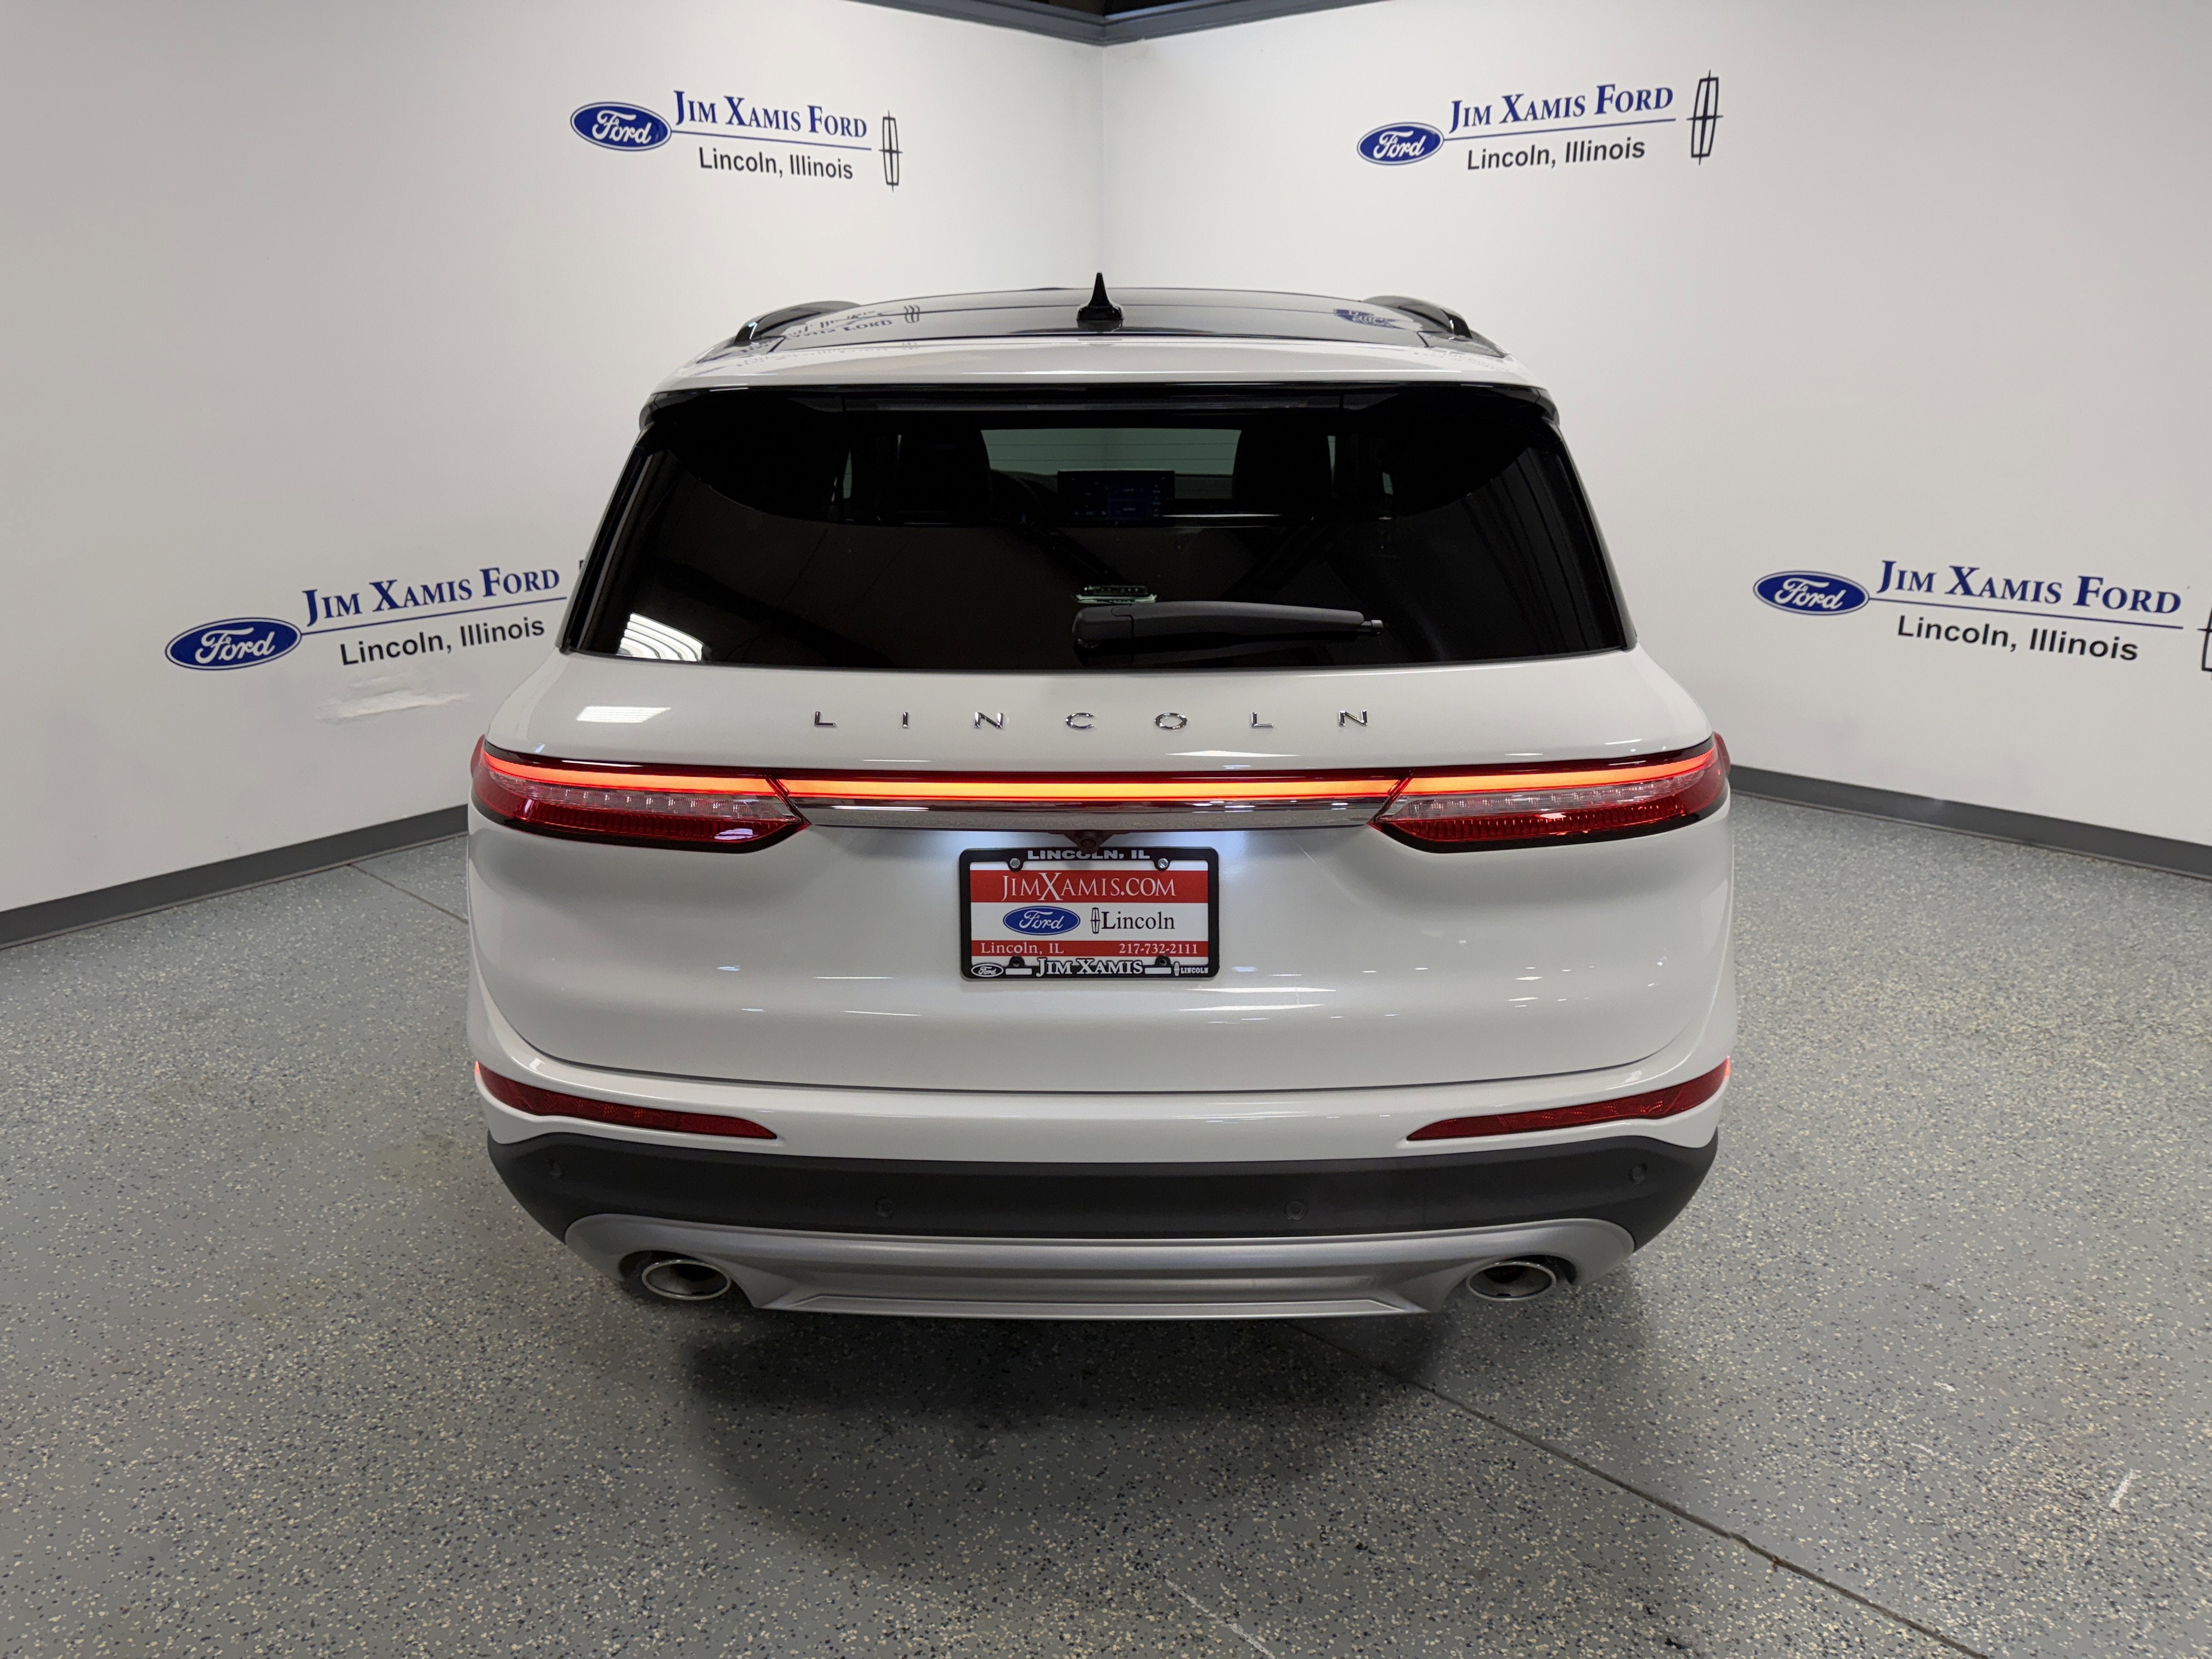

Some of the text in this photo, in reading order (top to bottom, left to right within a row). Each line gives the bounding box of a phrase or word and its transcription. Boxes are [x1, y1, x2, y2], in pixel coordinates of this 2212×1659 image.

[592, 110, 652, 144] Ford
[1373, 131, 1425, 159] Ford
[1467, 137, 1645, 170] Lincoln, Illinois
[698, 148, 853, 179] Lincoln, Illinois
[1774, 578, 1846, 611] Ford
[195, 628, 276, 663] Ford
[340, 617, 545, 666] Lincoln, Illinois
[1897, 615, 2139, 661] Lincoln, Illinois
[814, 709, 1367, 731] LINCOLN
[1131, 850, 1150, 859] IL
[1021, 910, 1064, 930] Ford
[1102, 911, 1175, 929] Lincoln
[981, 942, 1064, 955] Lincoln, IL
[1119, 944, 1198, 955] 217-732-2111
[978, 966, 996, 974] Ford
